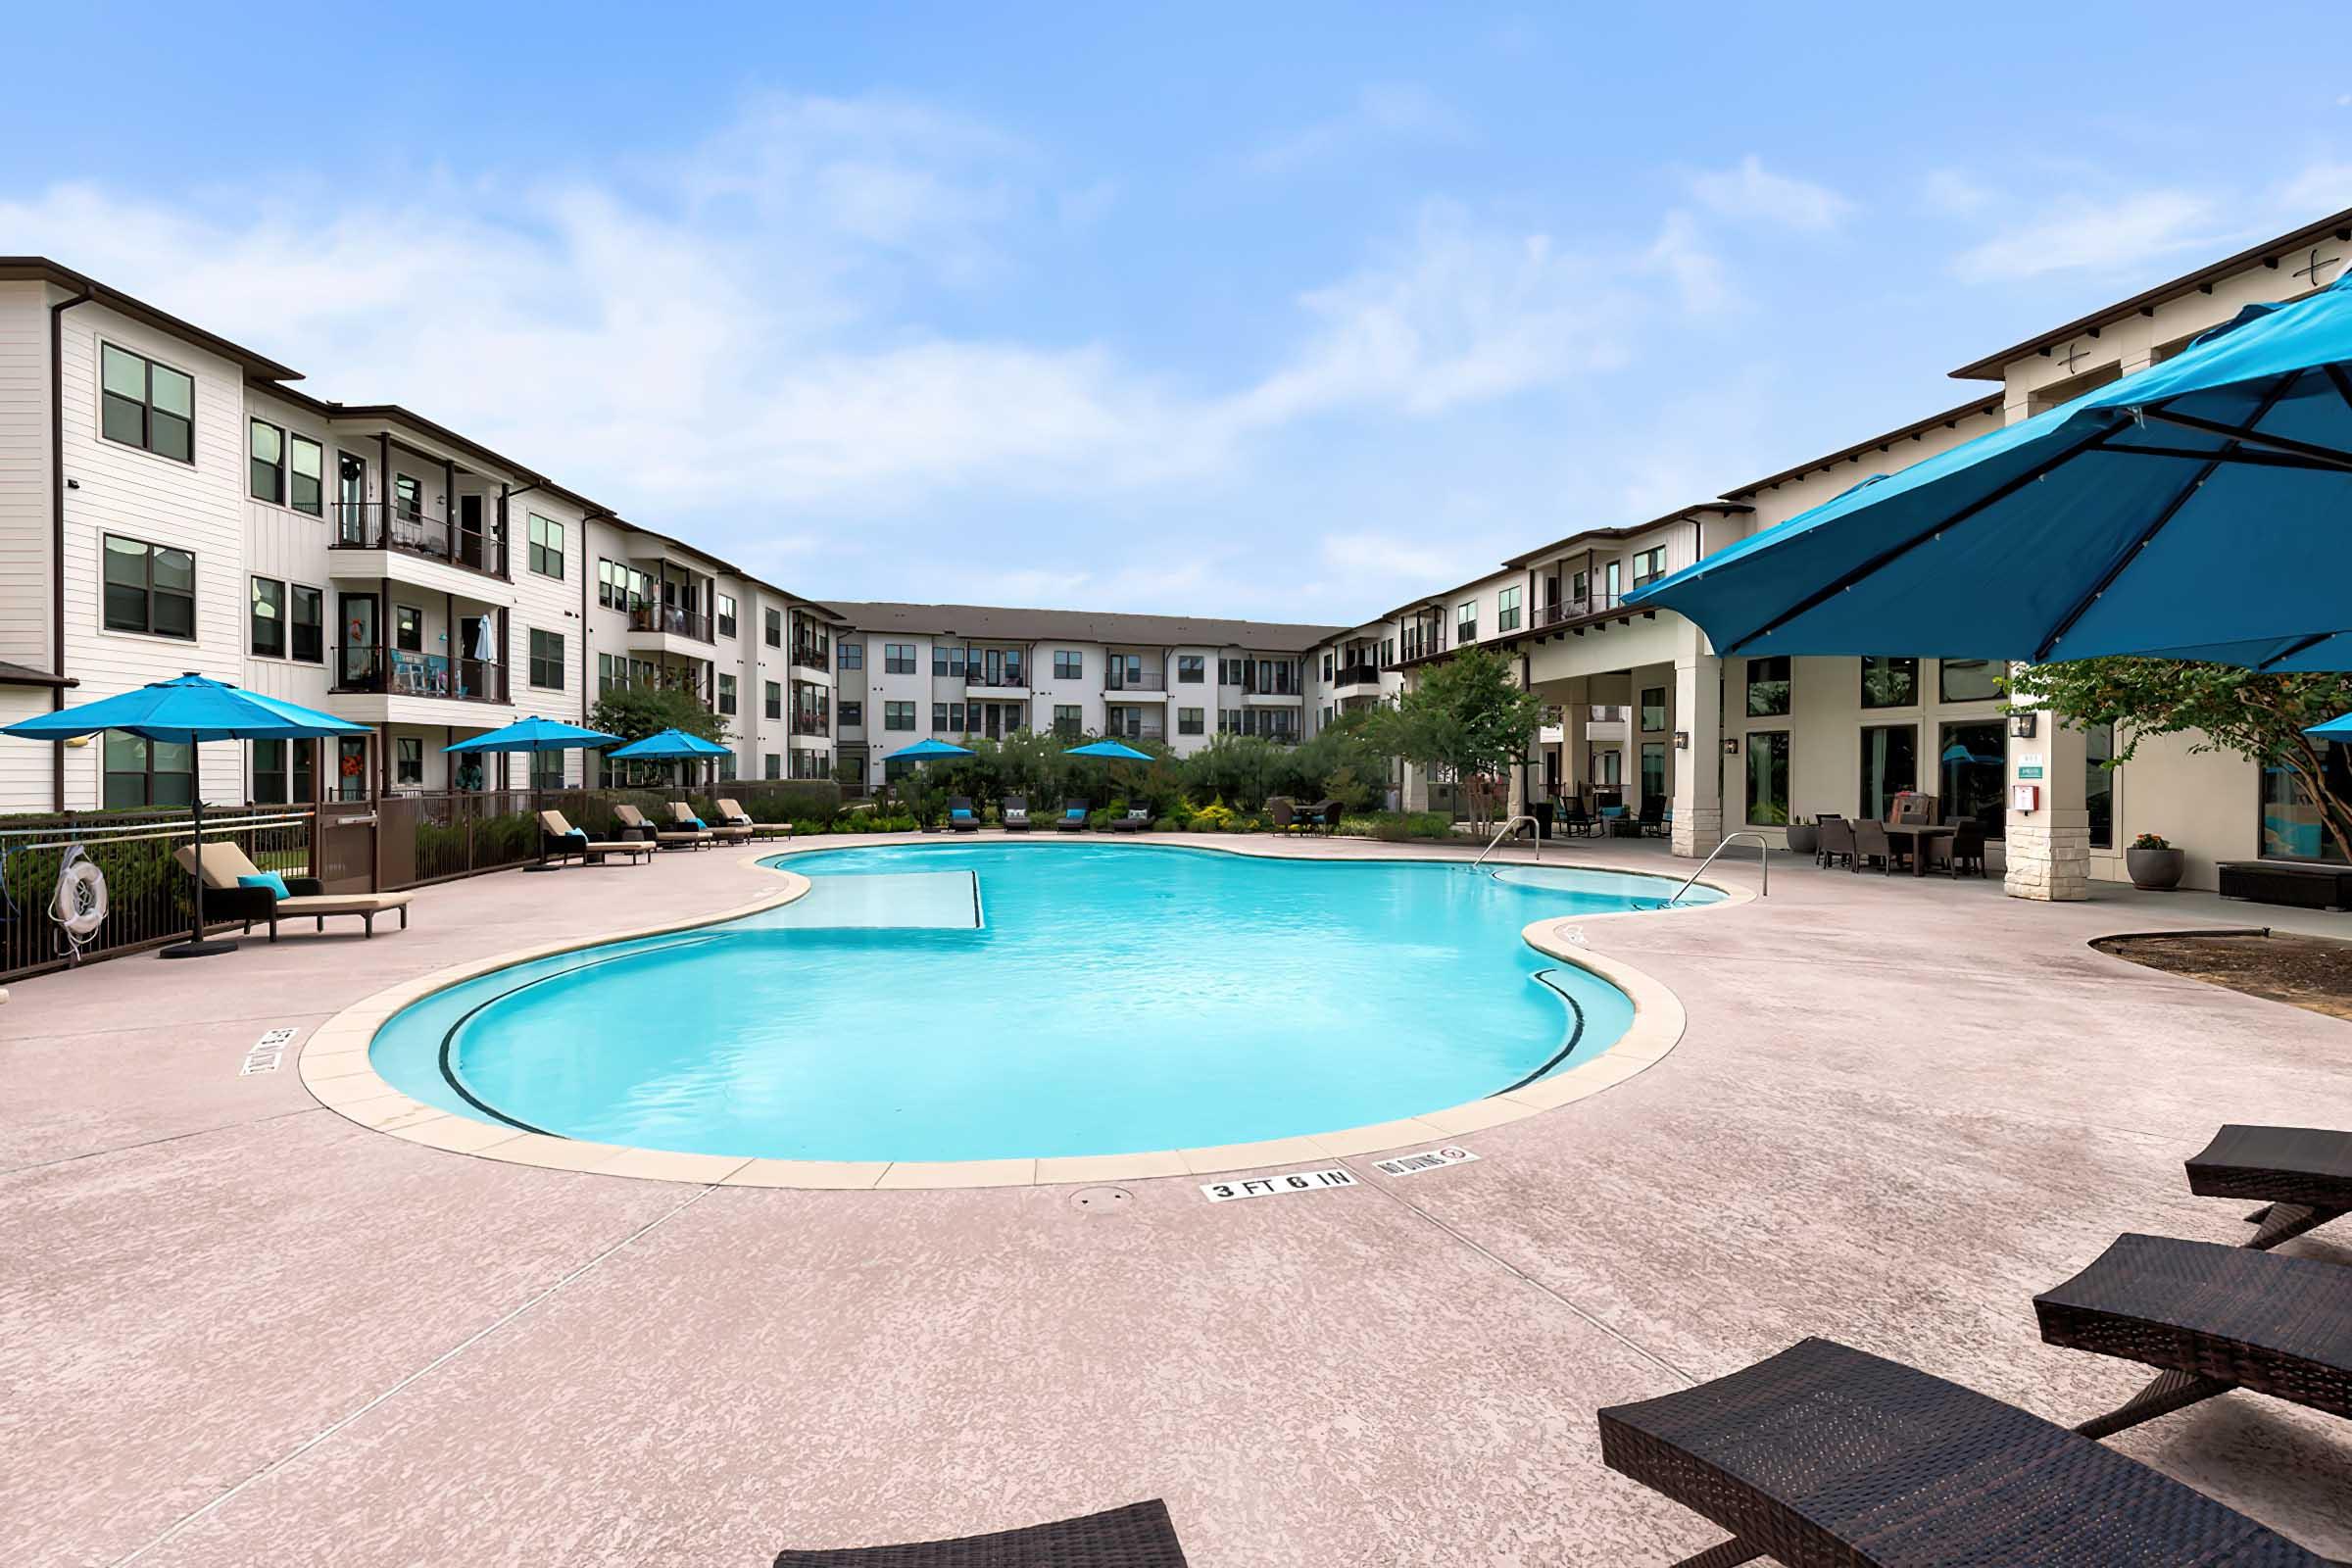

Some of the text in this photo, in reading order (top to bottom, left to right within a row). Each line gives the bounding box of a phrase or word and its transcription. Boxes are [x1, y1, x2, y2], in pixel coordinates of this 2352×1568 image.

[1377, 1162, 1405, 1174] NO
[1212, 1171, 1350, 1198] 3 FT 6 IN
